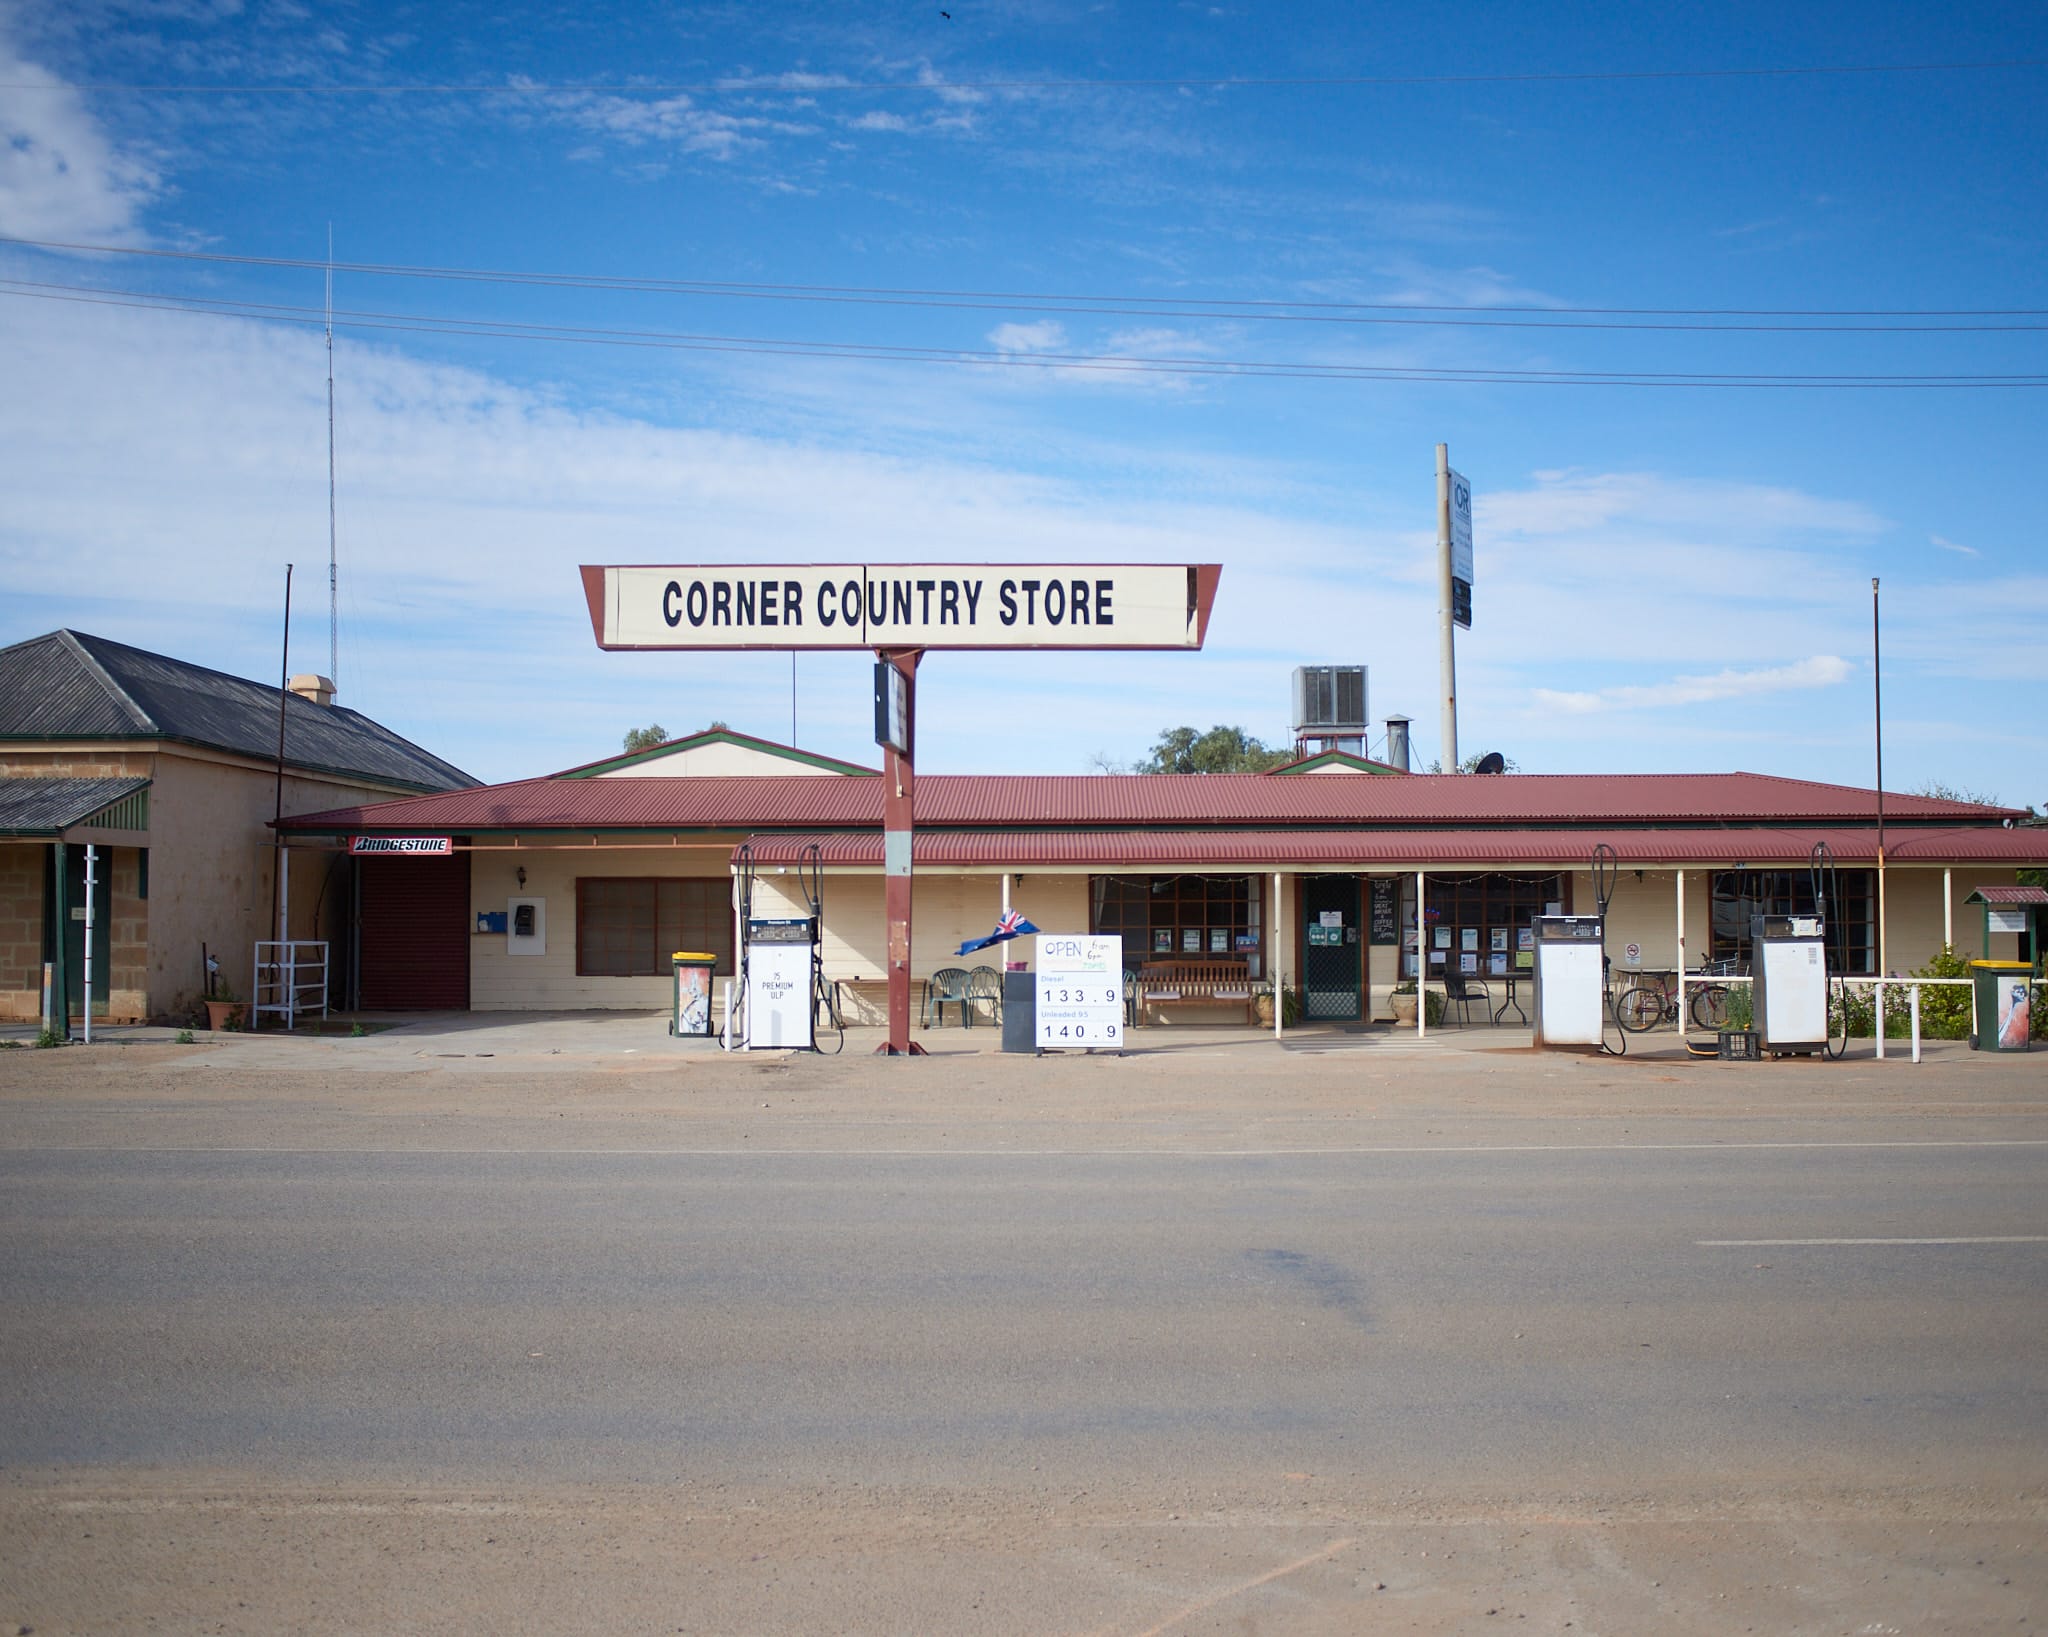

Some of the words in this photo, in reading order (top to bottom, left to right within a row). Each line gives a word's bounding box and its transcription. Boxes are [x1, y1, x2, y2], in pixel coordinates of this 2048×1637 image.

[663, 580, 803, 627] CORNER
[817, 580, 983, 627] COUNTRY
[999, 579, 1114, 626] STORE
[354, 837, 447, 852] BRIDGESTONE
[1045, 941, 1082, 957] OPEN
[1041, 975, 1064, 983] Diesel
[762, 981, 794, 991] PREMIUM
[770, 991, 784, 1000] ULP
[1044, 989, 1116, 1002] 133.9
[1041, 1010, 1077, 1018] Unleaded
[1078, 1010, 1089, 1018] 95
[1044, 1025, 1117, 1038] 140.9
